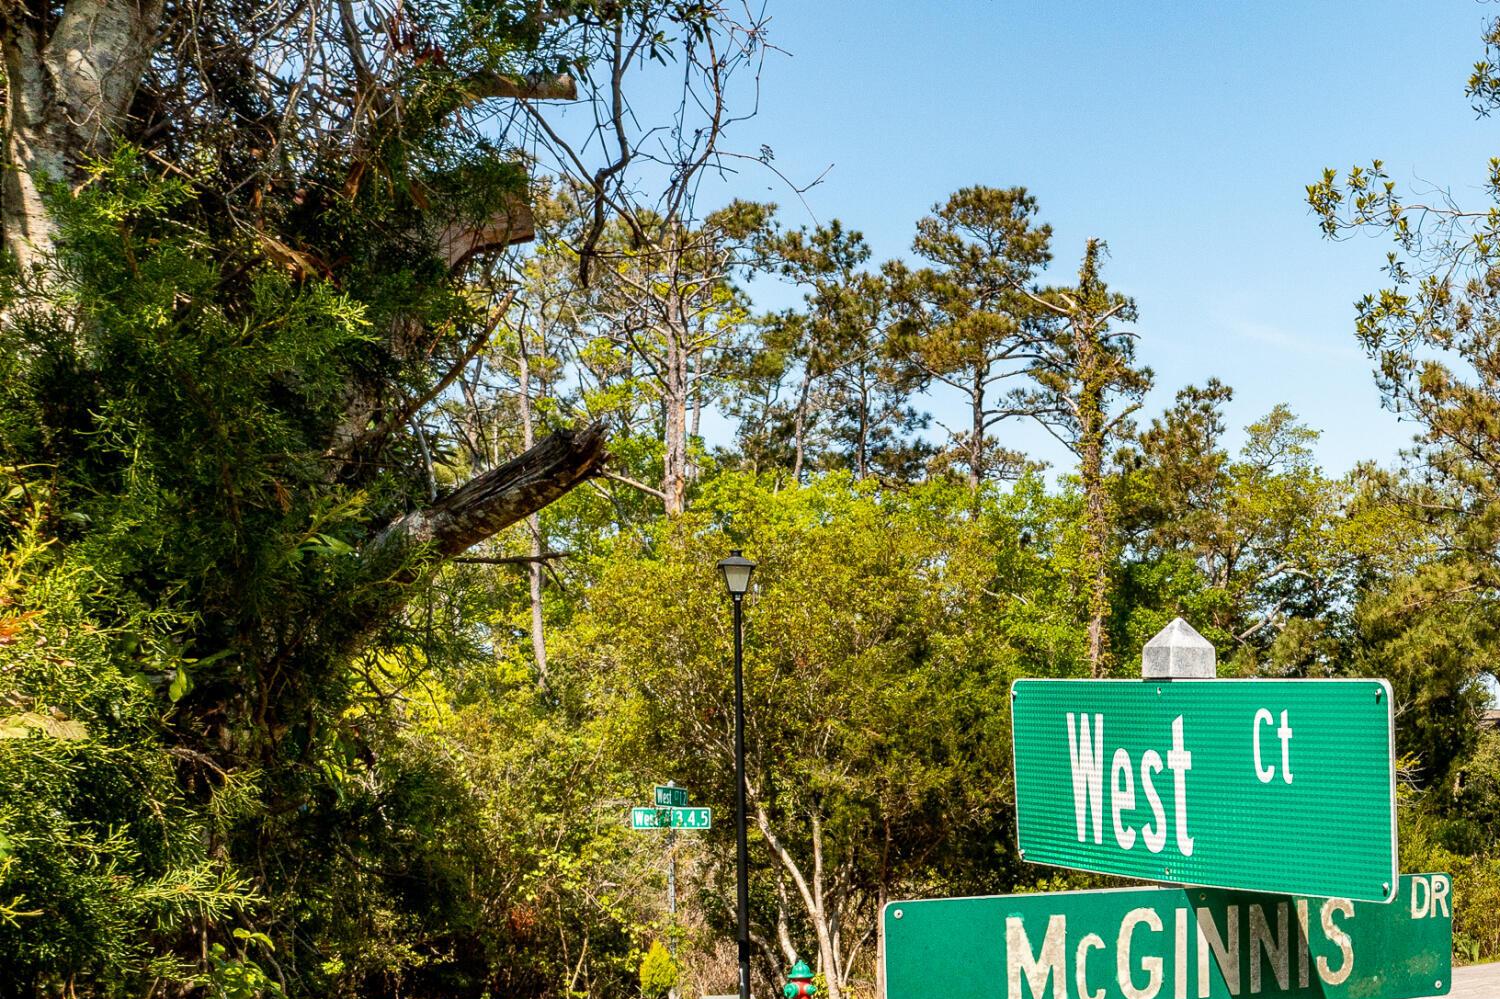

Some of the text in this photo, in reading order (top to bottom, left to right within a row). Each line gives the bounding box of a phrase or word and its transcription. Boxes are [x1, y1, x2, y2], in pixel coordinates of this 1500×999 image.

[1066, 707, 1294, 857] West Ct
[1411, 874, 1450, 919] DR
